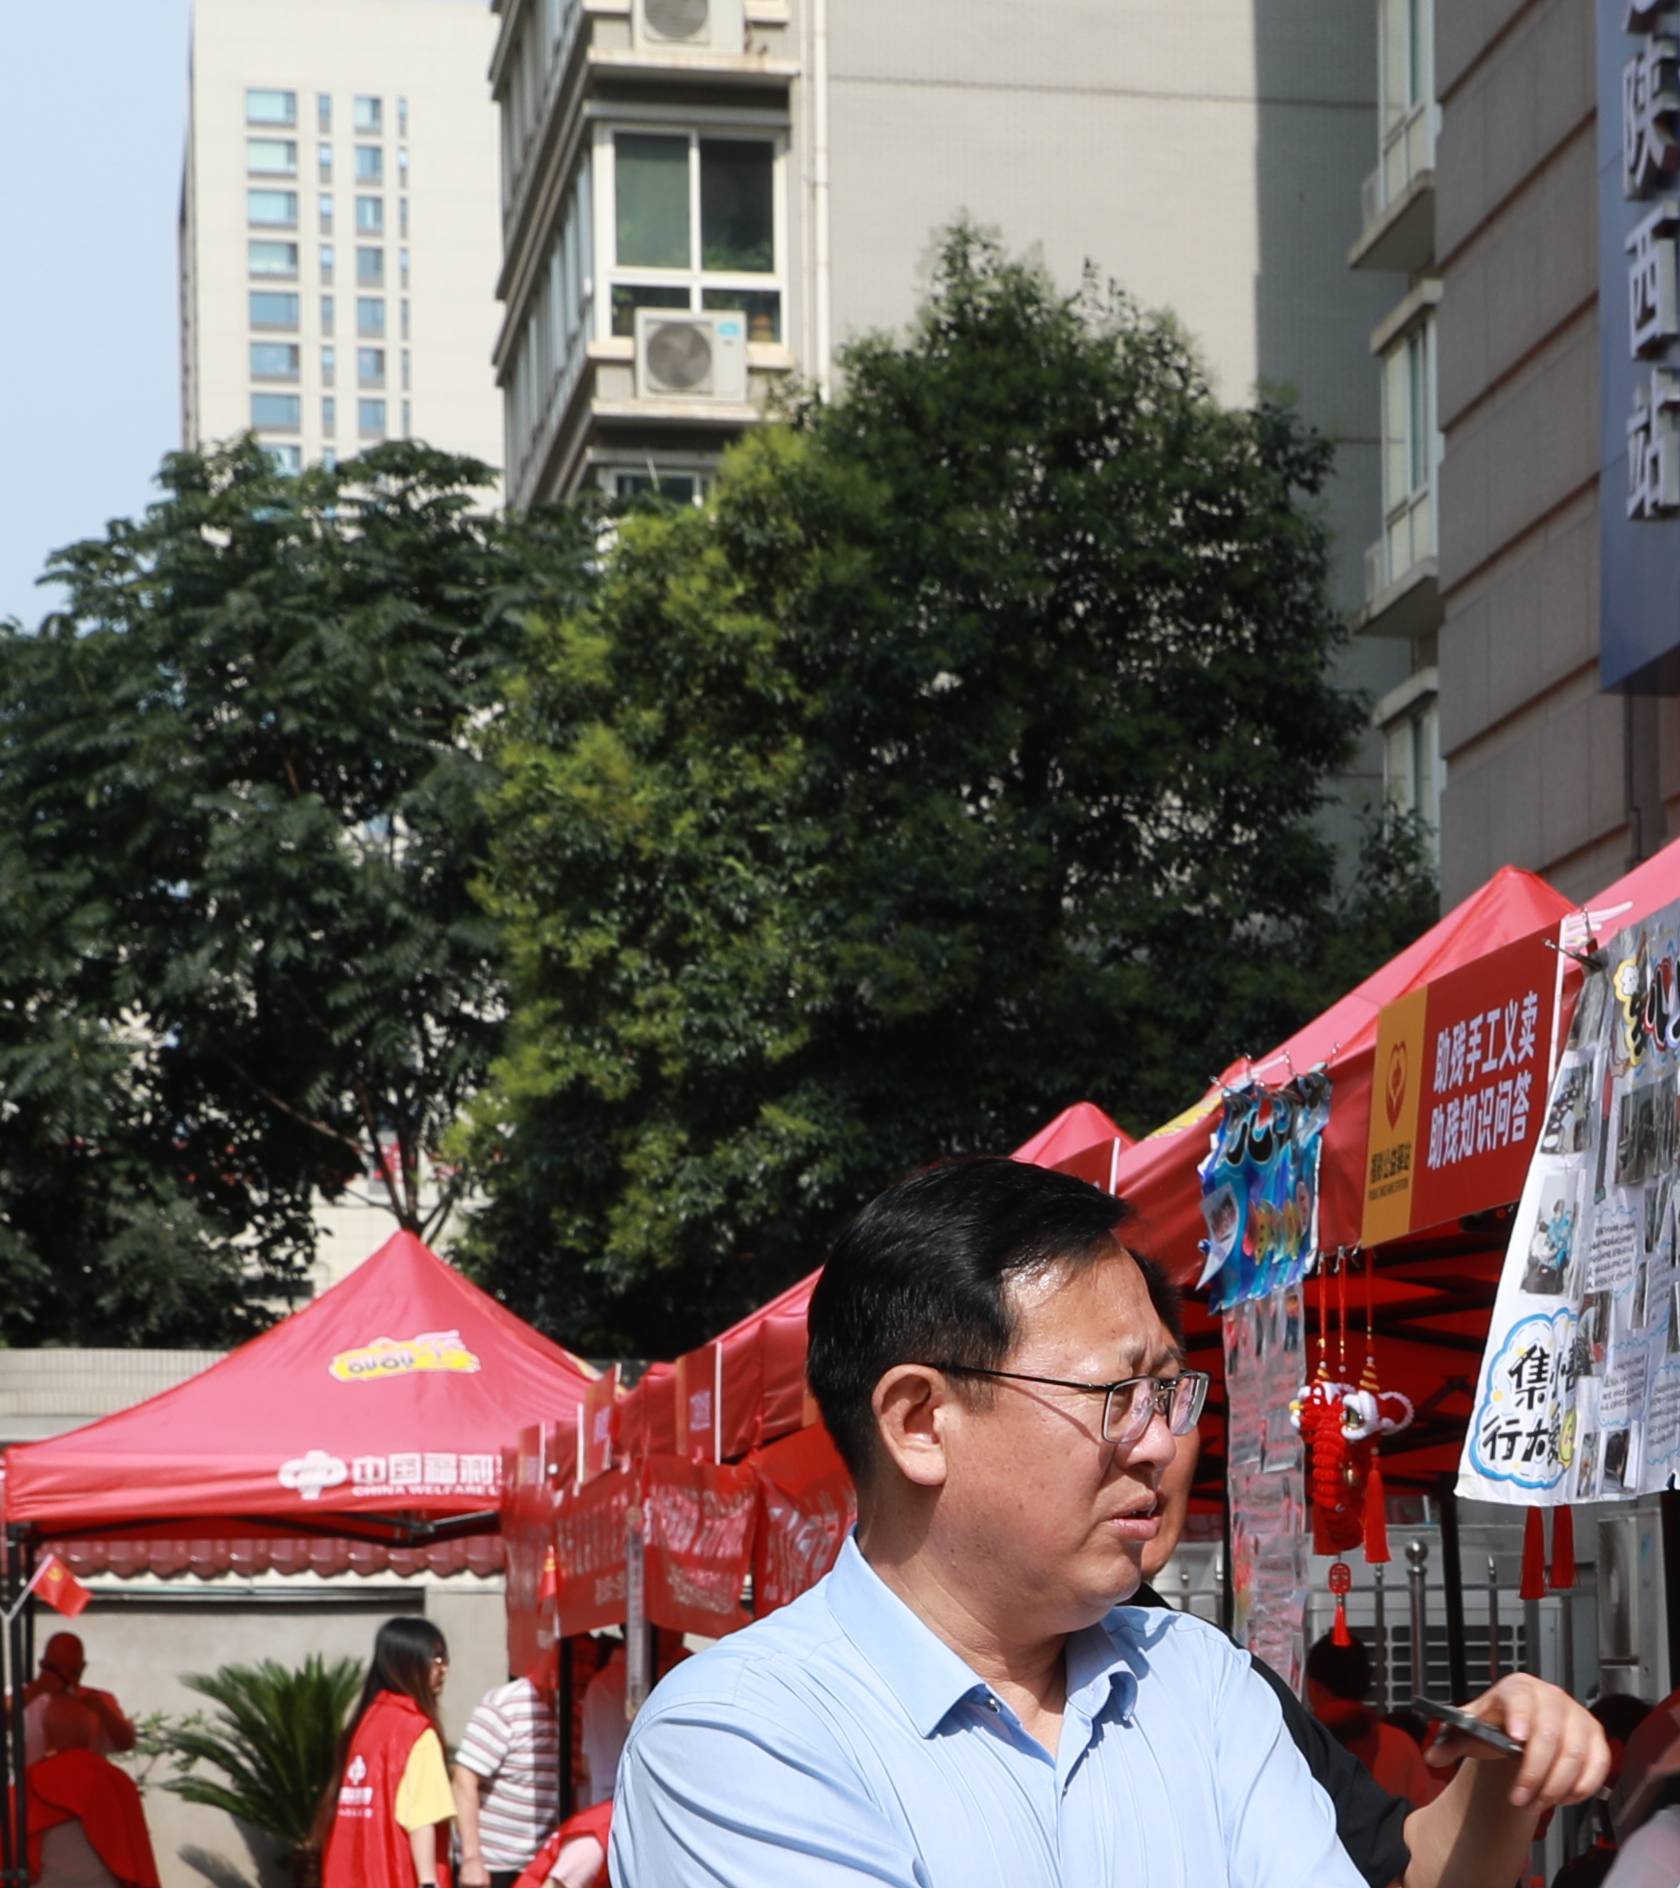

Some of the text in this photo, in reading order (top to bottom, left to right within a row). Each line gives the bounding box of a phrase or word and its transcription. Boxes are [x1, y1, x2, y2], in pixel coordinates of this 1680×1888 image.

[1623, 0, 1680, 520] 陕西站
[1433, 990, 1539, 1094] 助残手工义卖
[1427, 1070, 1532, 1170] 助残知识问答
[352, 1453, 502, 1487] 中国福利
